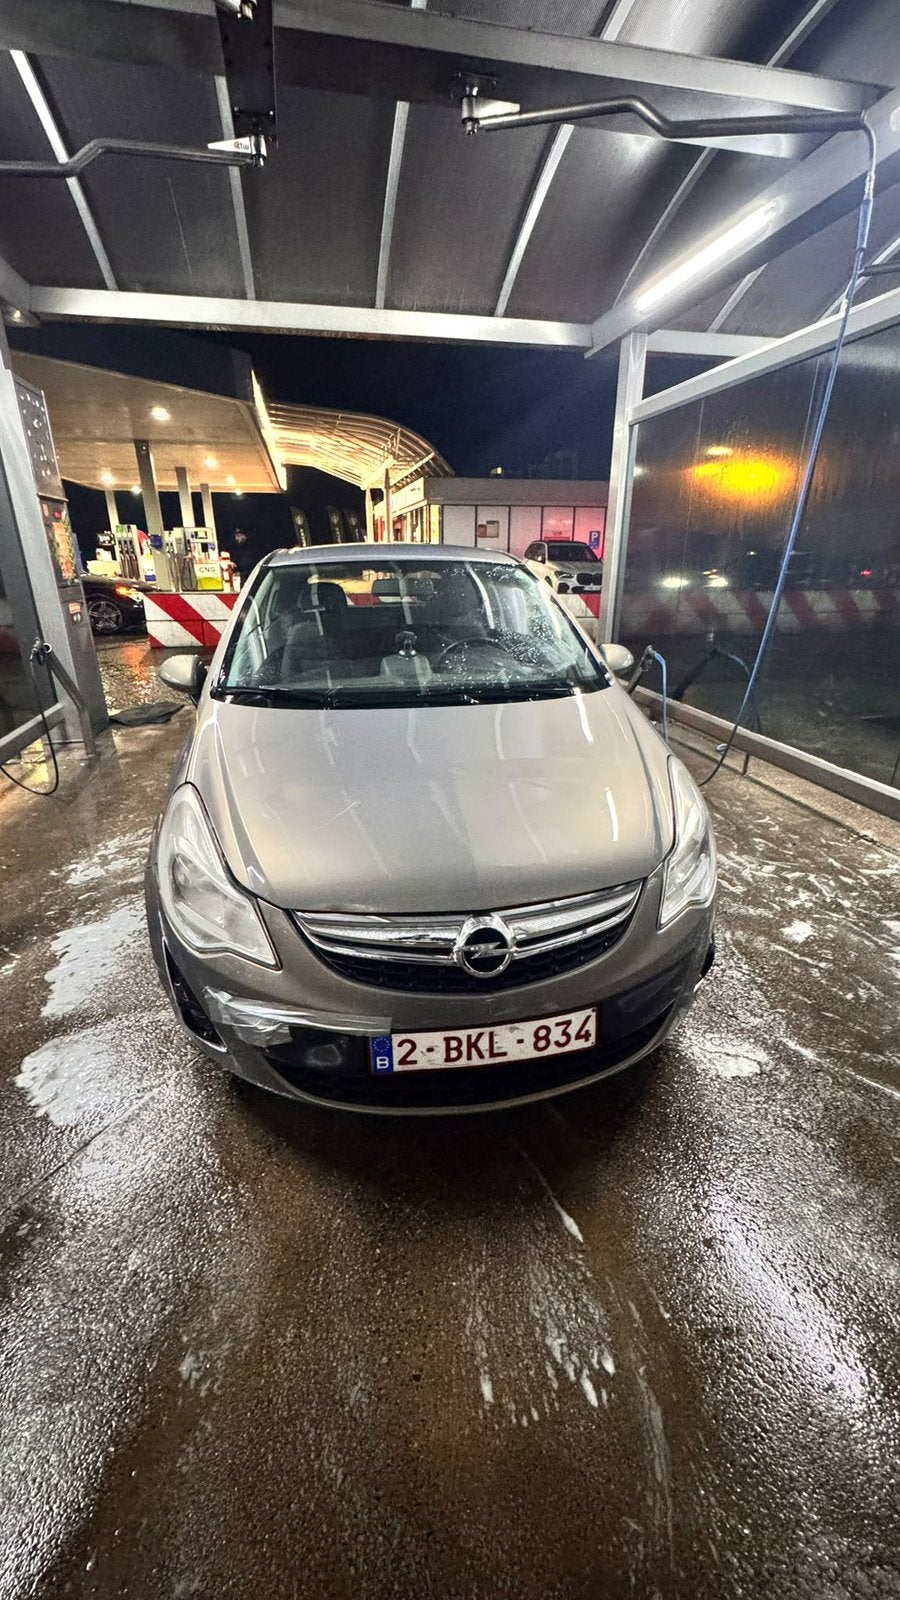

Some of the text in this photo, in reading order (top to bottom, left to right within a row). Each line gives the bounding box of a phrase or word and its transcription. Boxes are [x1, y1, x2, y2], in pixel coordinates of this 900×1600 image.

[592, 532, 599, 542] P
[199, 566, 216, 574] CNG
[376, 1056, 389, 1070] B
